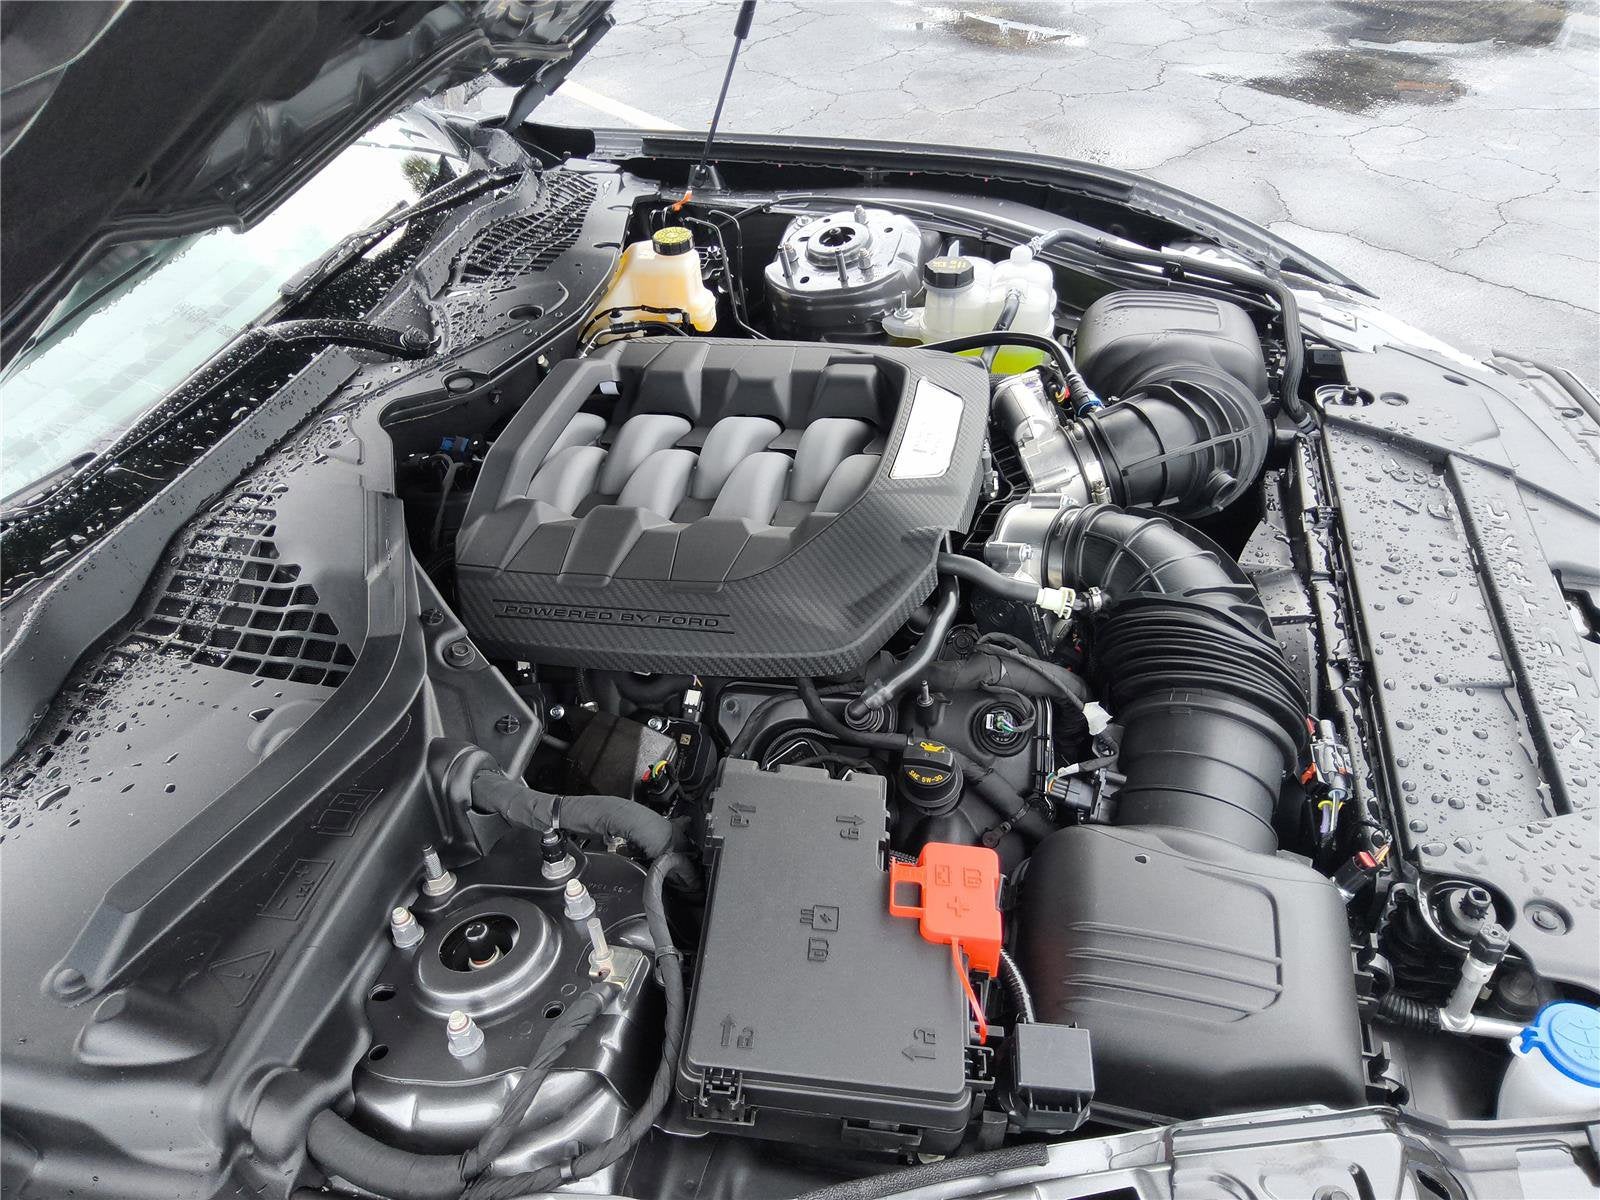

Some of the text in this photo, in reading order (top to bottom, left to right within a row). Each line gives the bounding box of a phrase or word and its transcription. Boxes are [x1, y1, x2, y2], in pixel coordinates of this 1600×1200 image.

[503, 604, 719, 628] POWERED BY FORD
[908, 770, 943, 783] SAE 5W-30
